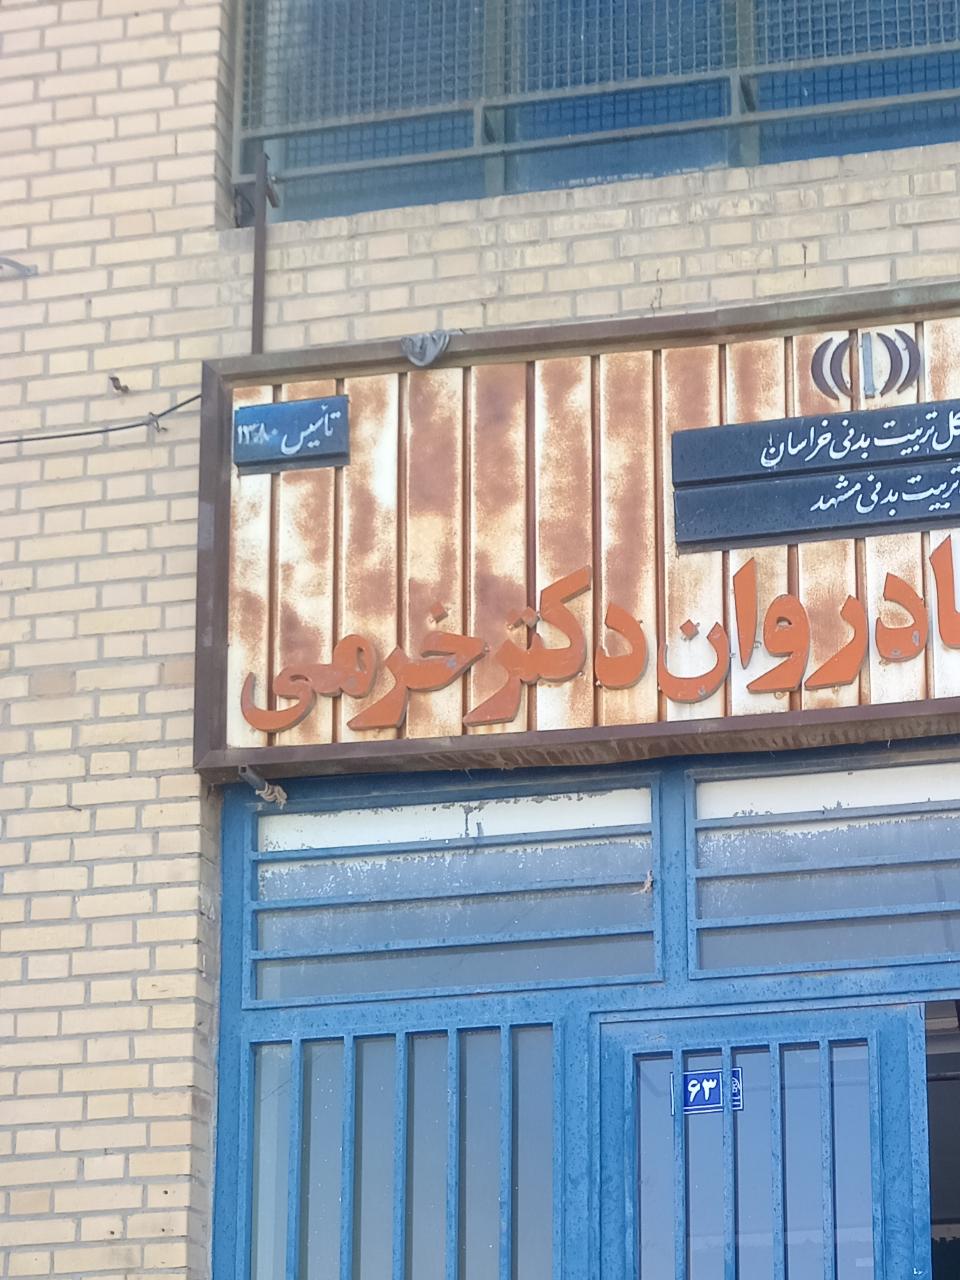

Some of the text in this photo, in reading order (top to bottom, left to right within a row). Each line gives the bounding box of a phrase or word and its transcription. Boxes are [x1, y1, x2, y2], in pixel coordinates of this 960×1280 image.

[760, 419, 832, 467] خراسان
[829, 419, 870, 460] بدنی
[874, 411, 938, 456] تربیت
[810, 475, 861, 511] مشهد
[856, 474, 898, 516] بدنی
[462, 565, 648, 727] دکتر
[687, 1079, 717, 1102] ۶۳
